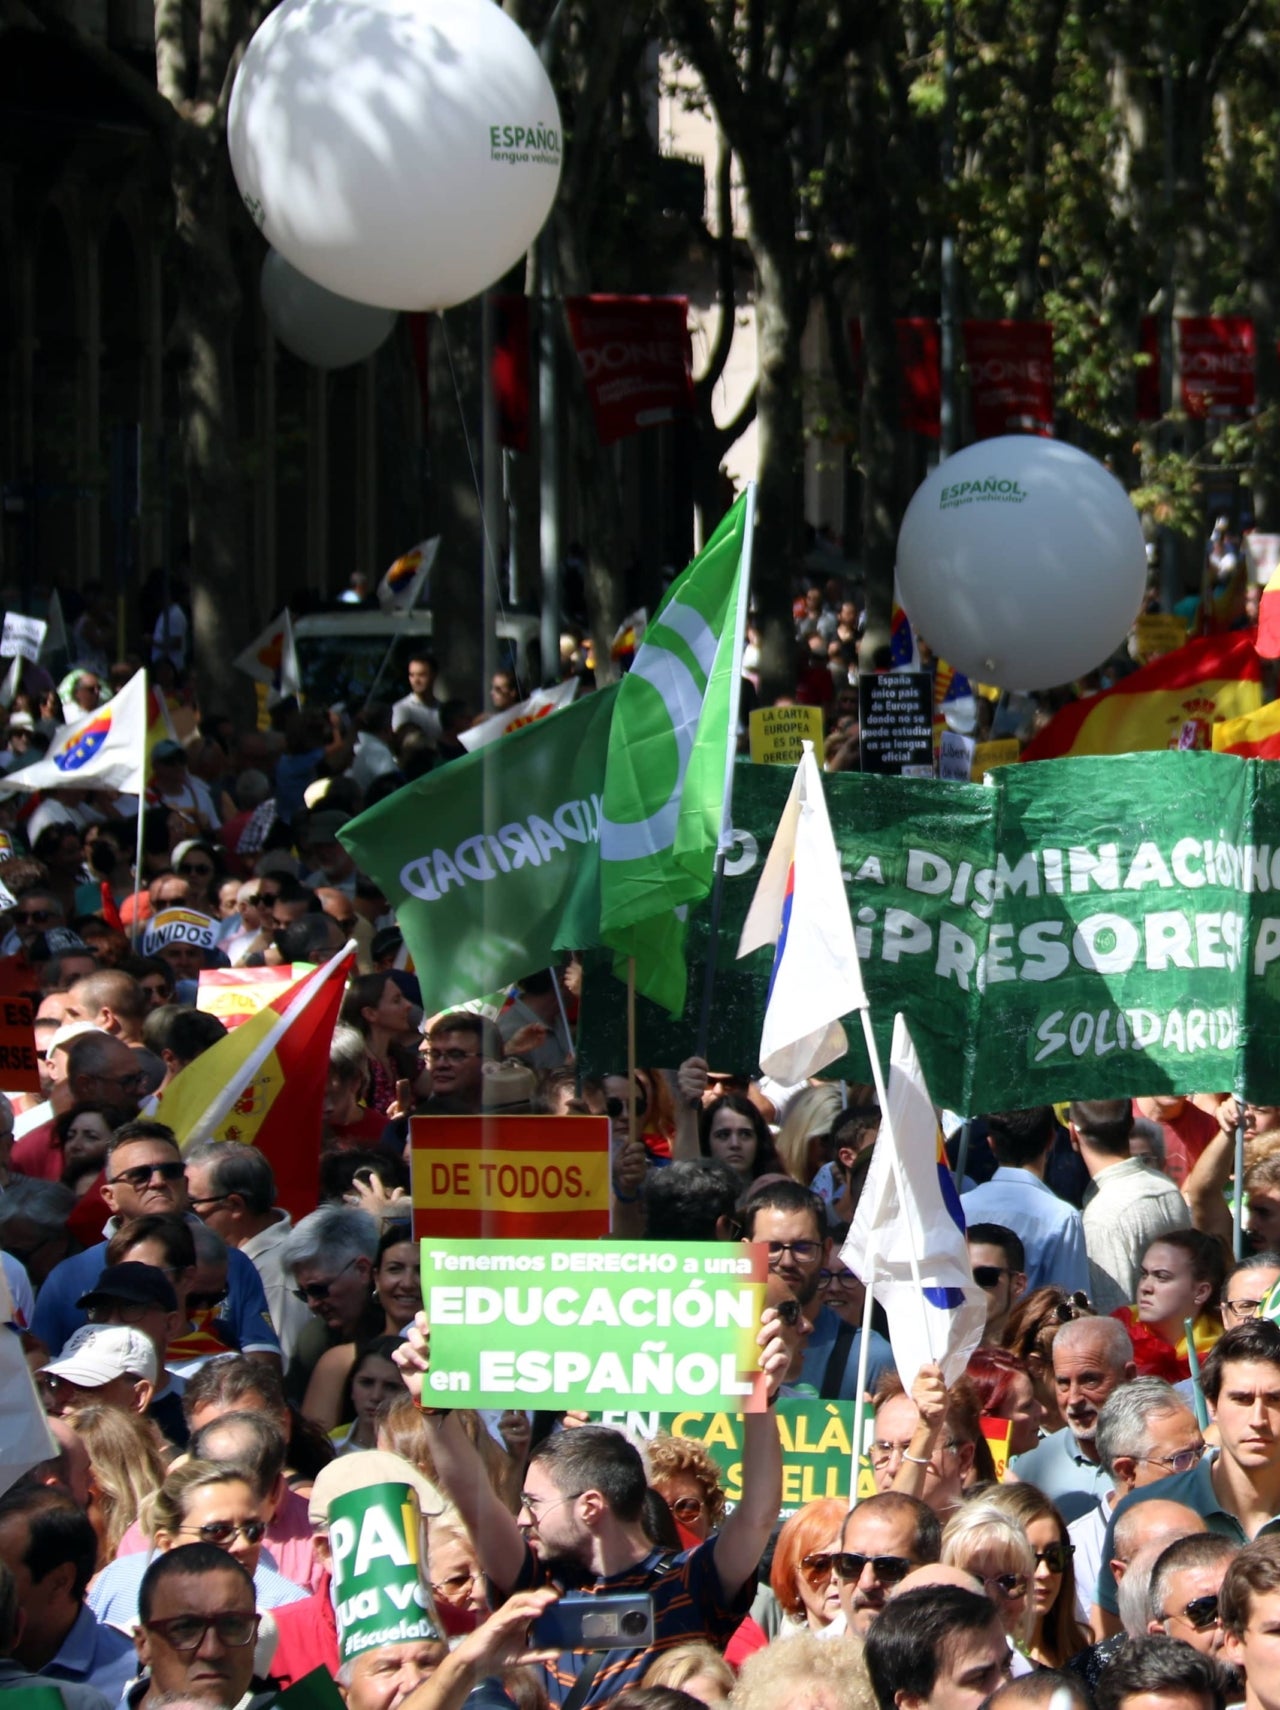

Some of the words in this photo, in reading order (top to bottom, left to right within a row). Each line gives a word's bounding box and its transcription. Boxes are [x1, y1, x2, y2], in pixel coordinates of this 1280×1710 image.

[491, 148, 529, 165] lengua
[940, 476, 1027, 502] ESPAÑOL,
[940, 496, 973, 511] lengua
[878, 674, 911, 688] España
[871, 701, 883, 712] de
[886, 700, 919, 713] Europa
[762, 711, 774, 721] LA
[778, 708, 809, 721] CARTA
[867, 714, 896, 725] donde
[898, 715, 911, 725] no
[913, 715, 925, 725] se
[764, 722, 809, 736] EUROPEA
[862, 727, 889, 740] puede
[892, 725, 931, 736] estudiar
[773, 737, 786, 748] ES
[867, 741, 878, 751] en
[880, 740, 891, 749] su
[894, 738, 927, 752] lengua
[881, 751, 911, 763] oficial
[146, 923, 213, 953] UNIDOS
[431, 1163, 471, 1196] DE
[479, 1164, 591, 1199] TODOS.
[430, 1251, 545, 1272] Tenemos
[551, 1252, 677, 1274] DERECHO
[683, 1257, 699, 1274] a
[704, 1256, 752, 1274] una
[430, 1279, 754, 1328] EDUCACIÓN
[430, 1370, 471, 1392] en
[479, 1341, 754, 1397] ESPAÑOL
